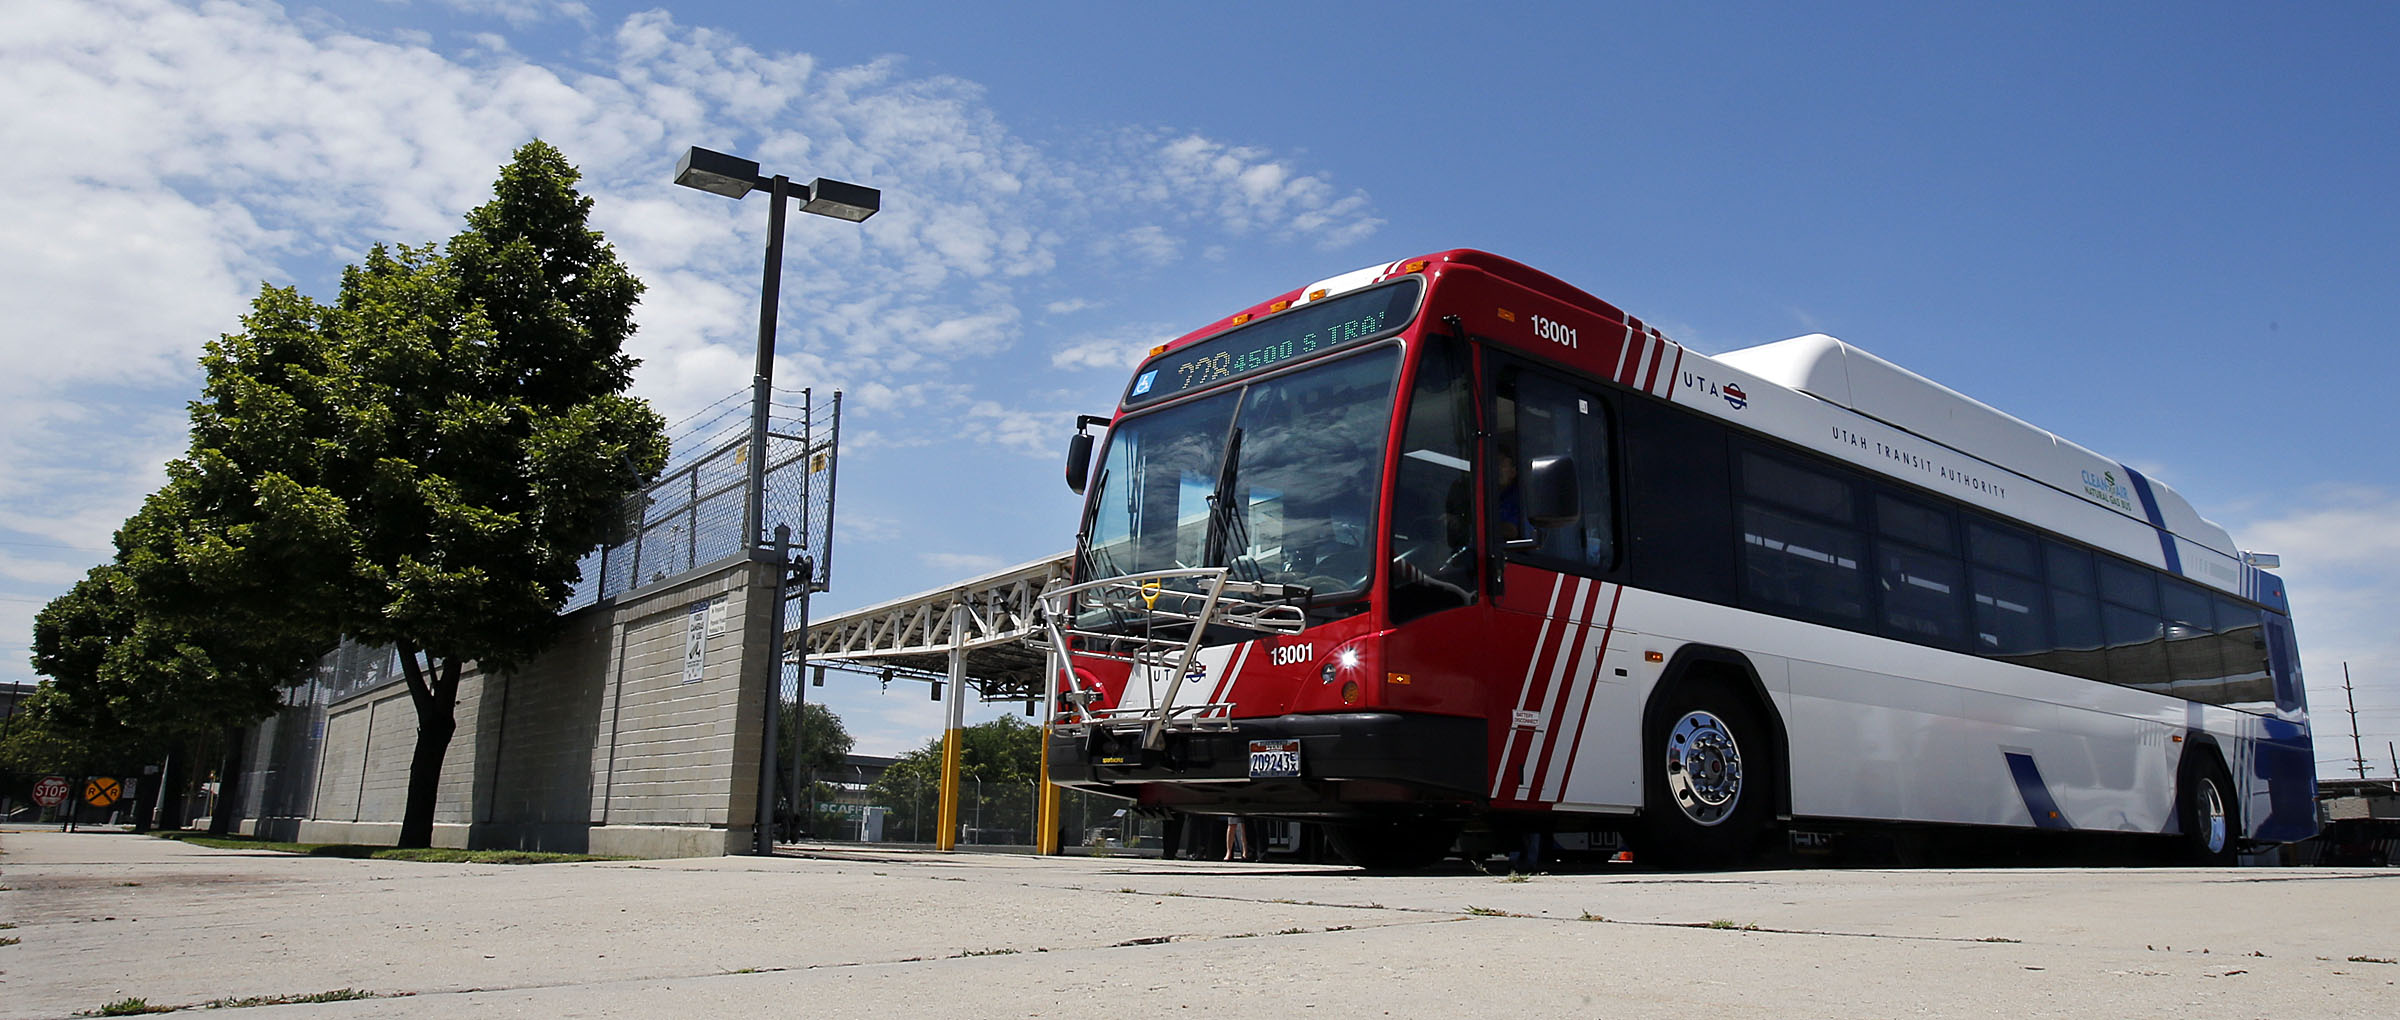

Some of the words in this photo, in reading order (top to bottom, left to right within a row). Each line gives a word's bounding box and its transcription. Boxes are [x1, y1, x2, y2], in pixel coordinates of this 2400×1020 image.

[1531, 314, 1577, 349] 13001
[1233, 340, 1293, 372] 4500
[1303, 332, 1317, 353] S
[1683, 371, 1719, 397] UTA
[1832, 426, 1867, 450] UTAH
[1876, 442, 1931, 472] TRANSIT
[1940, 466, 2006, 499] AUTHORITY
[2081, 469, 2108, 491] CLEAN
[2084, 485, 2109, 503] NATURAL
[2109, 495, 2121, 507] GAS
[2120, 499, 2132, 511] BUS
[1270, 642, 1313, 666] 13001
[35, 785, 68, 797] STOP
[88, 787, 96, 796] R
[110, 787, 118, 796] R
